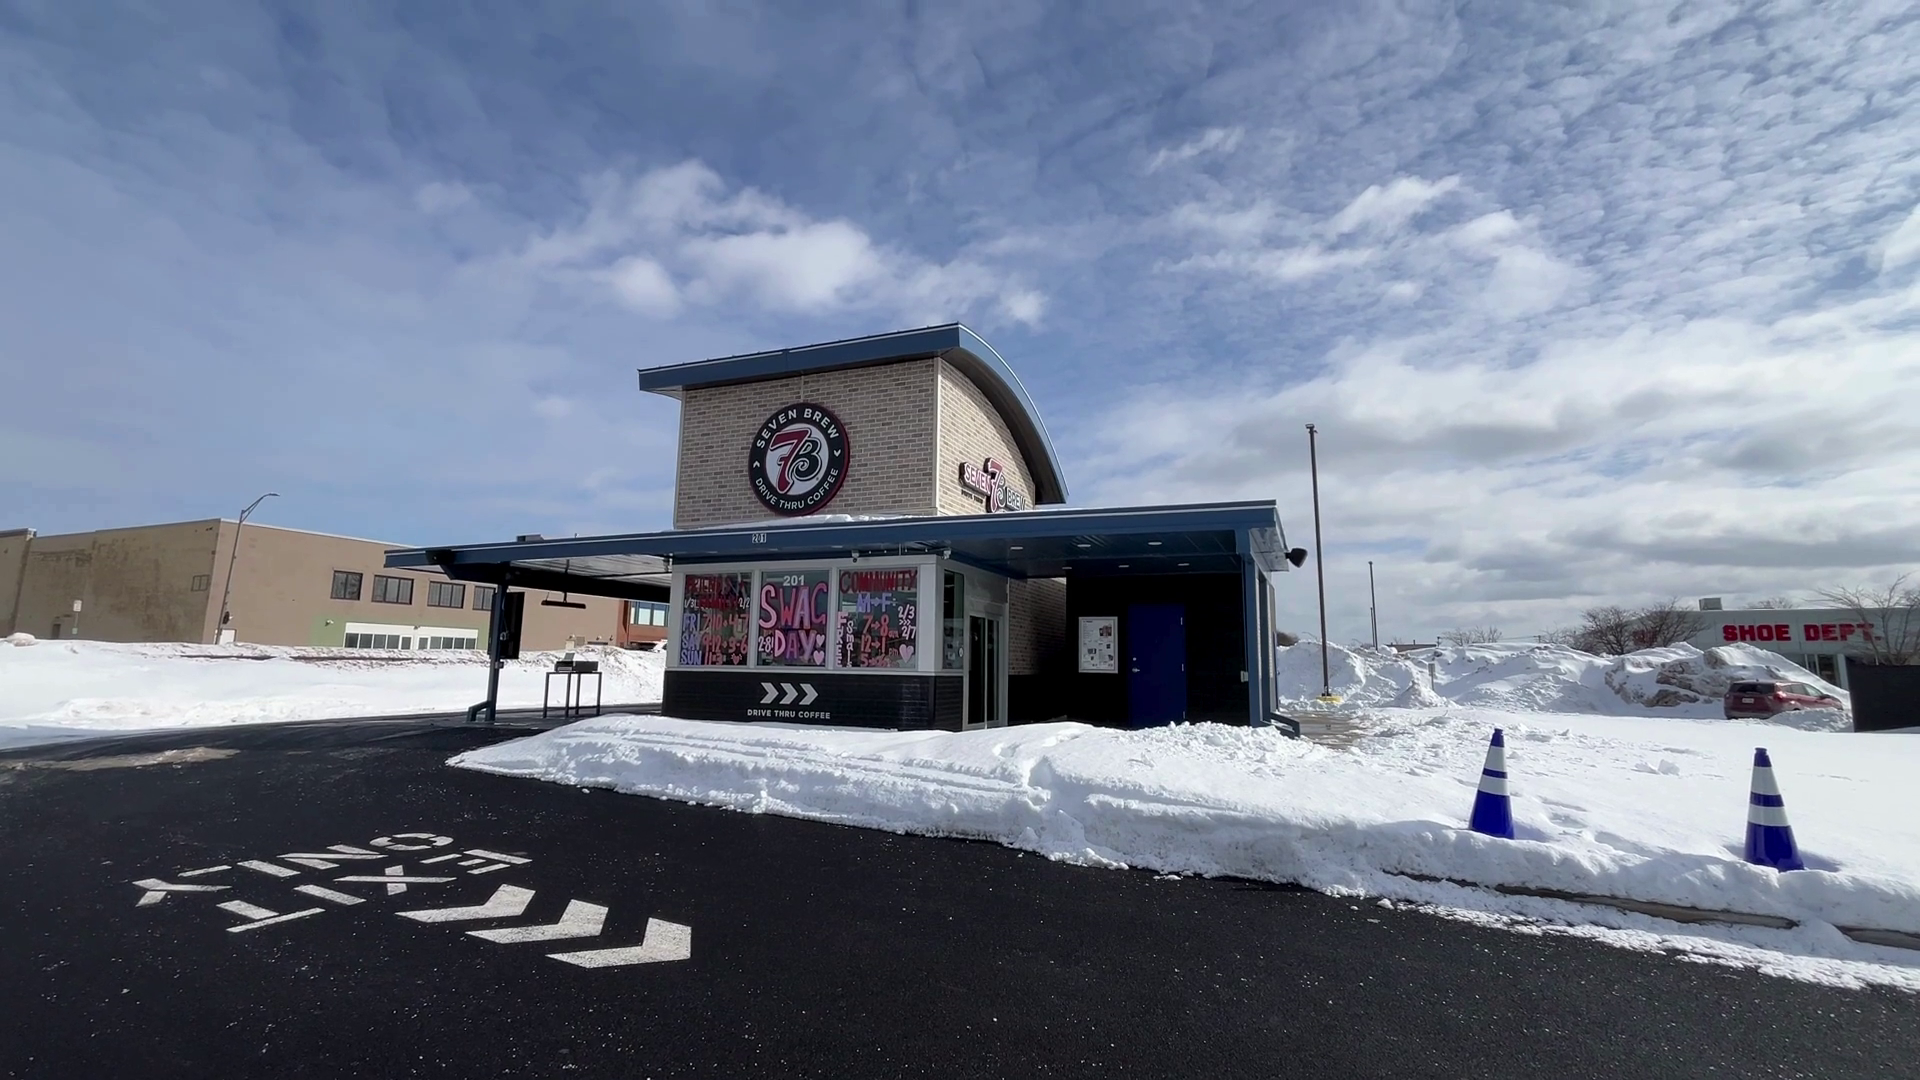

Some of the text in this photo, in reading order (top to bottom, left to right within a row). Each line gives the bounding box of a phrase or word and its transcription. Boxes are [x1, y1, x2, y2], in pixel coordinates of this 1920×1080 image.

[757, 408, 840, 449] SEVEN BREW
[964, 462, 991, 495] SEVEN
[755, 467, 839, 510] DRIVE THRU COFFEE
[1006, 487, 1026, 511] BREW
[752, 533, 767, 544] 201
[783, 575, 806, 586] 201
[840, 569, 918, 594] COMMUNITY
[758, 582, 827, 629] SWAG
[898, 604, 915, 619] 2/3
[683, 613, 701, 632] FRI
[863, 614, 873, 634] 7
[880, 614, 889, 636] 8
[902, 624, 917, 640] 2/7
[681, 632, 701, 651] SAT
[836, 611, 848, 667] FREE
[1722, 623, 1882, 642] SHOE DEPT.
[774, 629, 818, 662] DAY
[861, 635, 872, 653] 12
[680, 650, 702, 665] SUN
[747, 709, 831, 719] DRIVE THRU COFFEE
